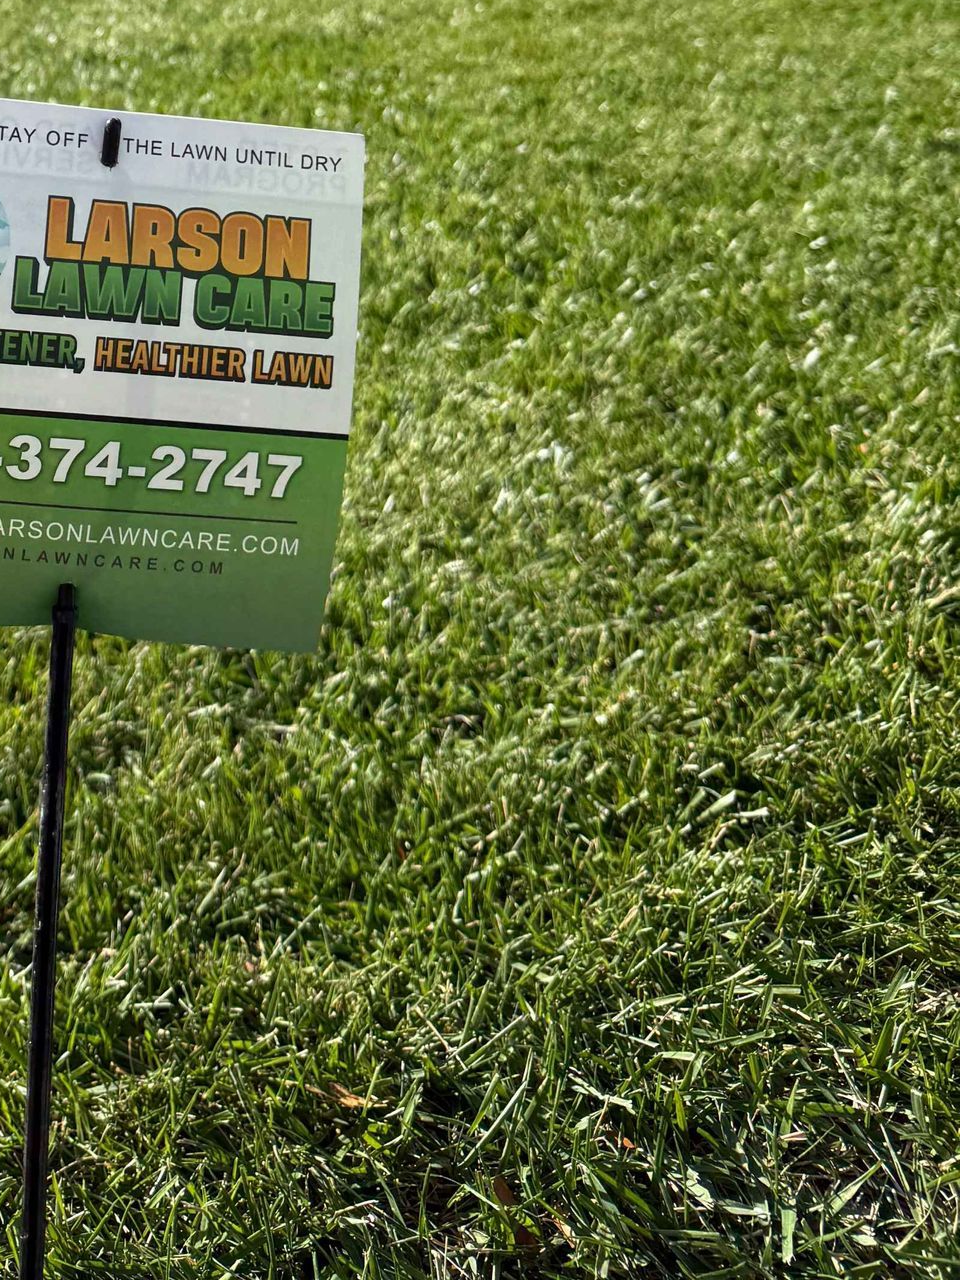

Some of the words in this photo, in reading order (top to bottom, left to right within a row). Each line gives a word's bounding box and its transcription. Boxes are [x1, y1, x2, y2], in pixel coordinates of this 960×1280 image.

[46, 130, 89, 149] OFF
[123, 138, 162, 156] THE
[171, 142, 227, 162] LAWN
[236, 148, 293, 168] UNTIL
[301, 154, 342, 173] DRY
[44, 195, 312, 280] LARSON
[11, 255, 184, 327] LAWN
[193, 273, 336, 339] CARE
[93, 336, 246, 383] HEALTHIER
[251, 349, 334, 389] LAWN
